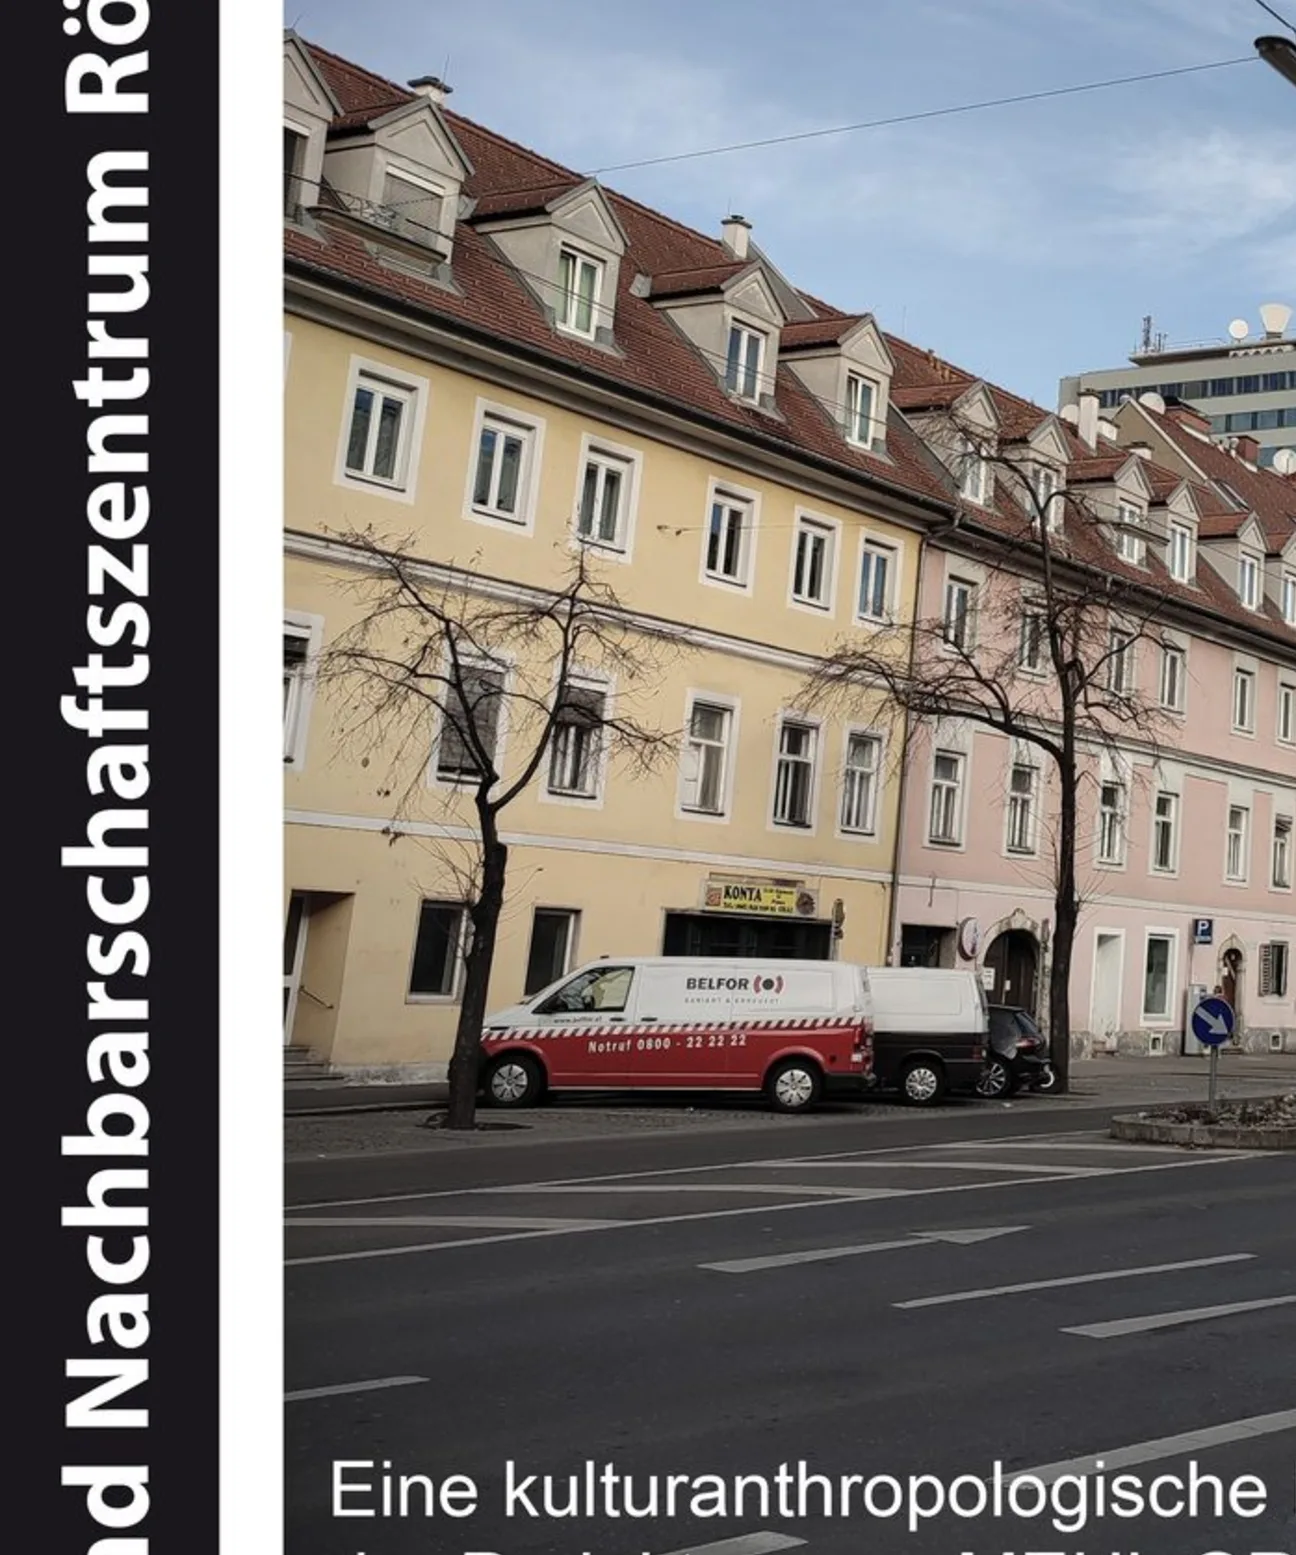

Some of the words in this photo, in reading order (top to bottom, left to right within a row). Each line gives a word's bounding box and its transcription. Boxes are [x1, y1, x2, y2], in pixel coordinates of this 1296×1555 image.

[723, 886, 762, 903] KONTA
[1197, 920, 1209, 935] P
[686, 978, 749, 990] BELFOR
[588, 1039, 631, 1053] Notruf
[636, 1037, 671, 1050] 0800
[686, 1036, 702, 1048] 22
[708, 1035, 725, 1047] 22
[731, 1034, 747, 1046] 22
